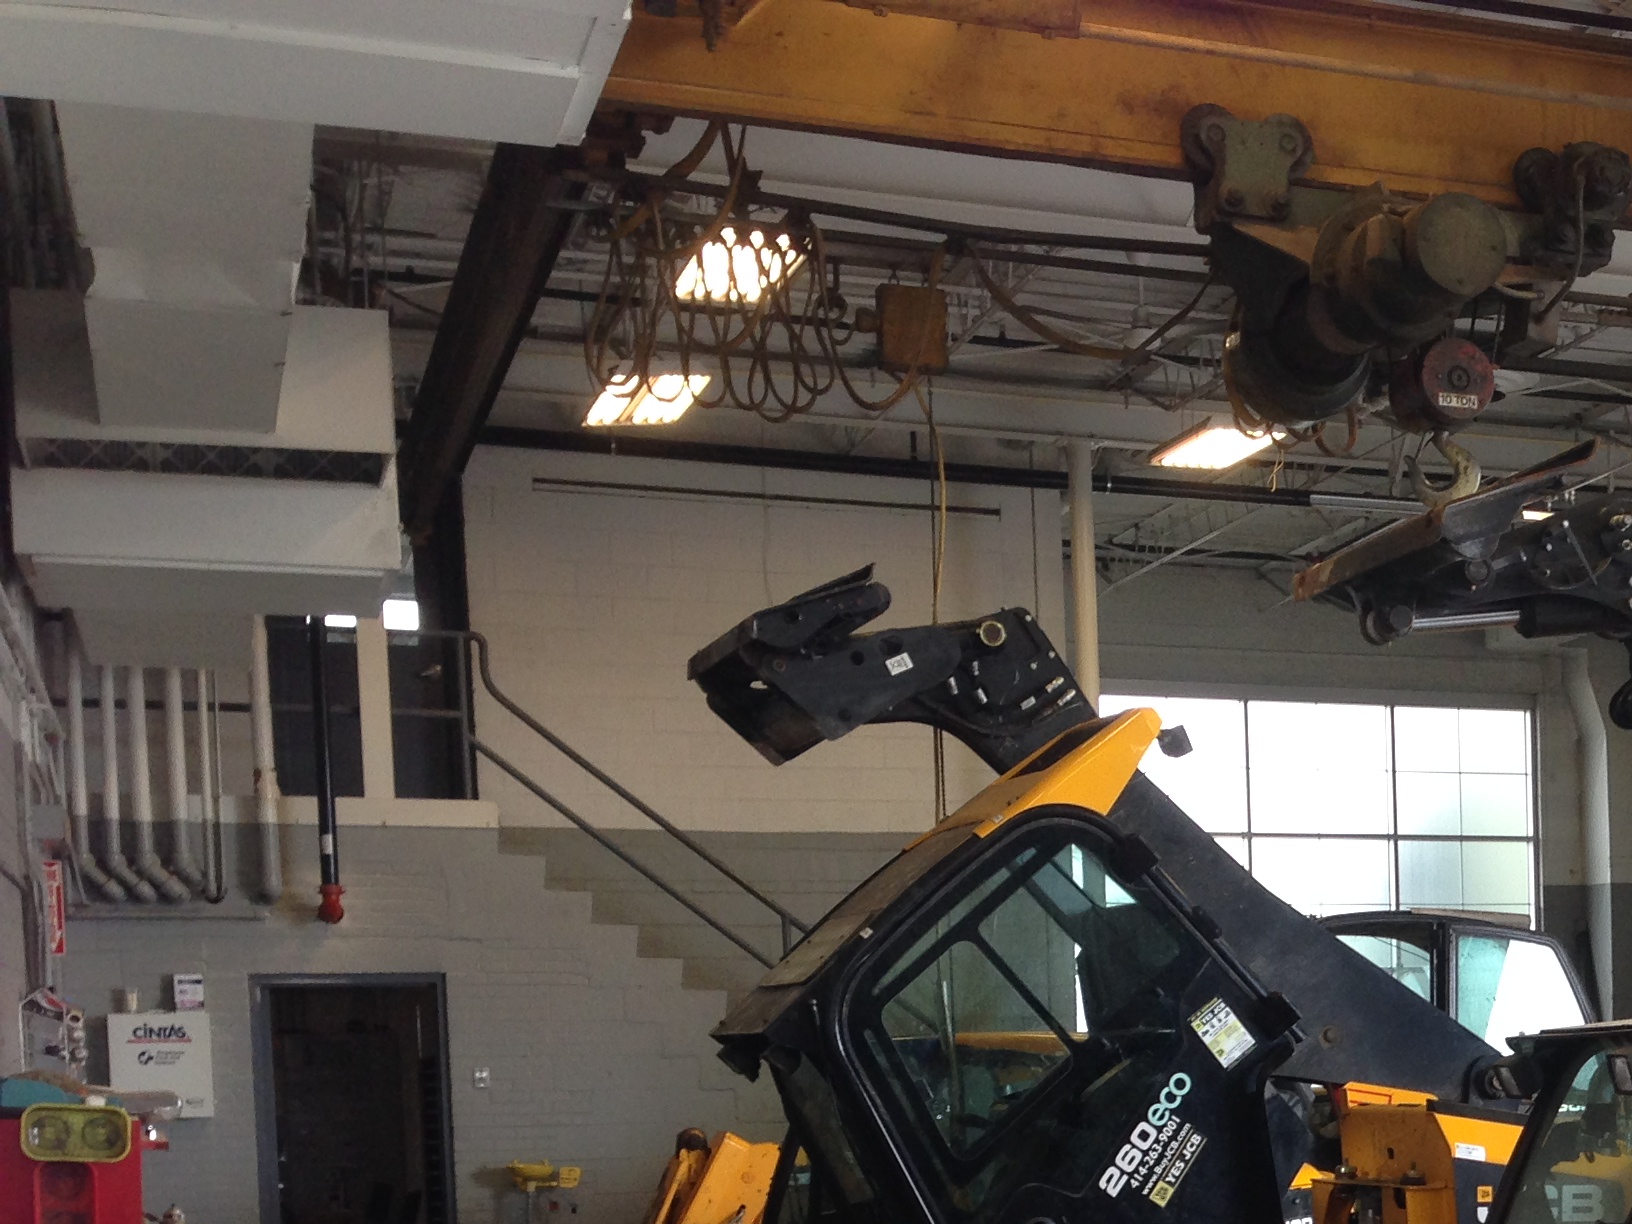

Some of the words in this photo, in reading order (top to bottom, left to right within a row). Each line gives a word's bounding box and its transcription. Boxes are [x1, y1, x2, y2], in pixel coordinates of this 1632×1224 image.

[1129, 1115, 1181, 1189] 414-263-9001
[1165, 1160, 1186, 1183] YES
[1182, 1133, 1203, 1160] JCB
